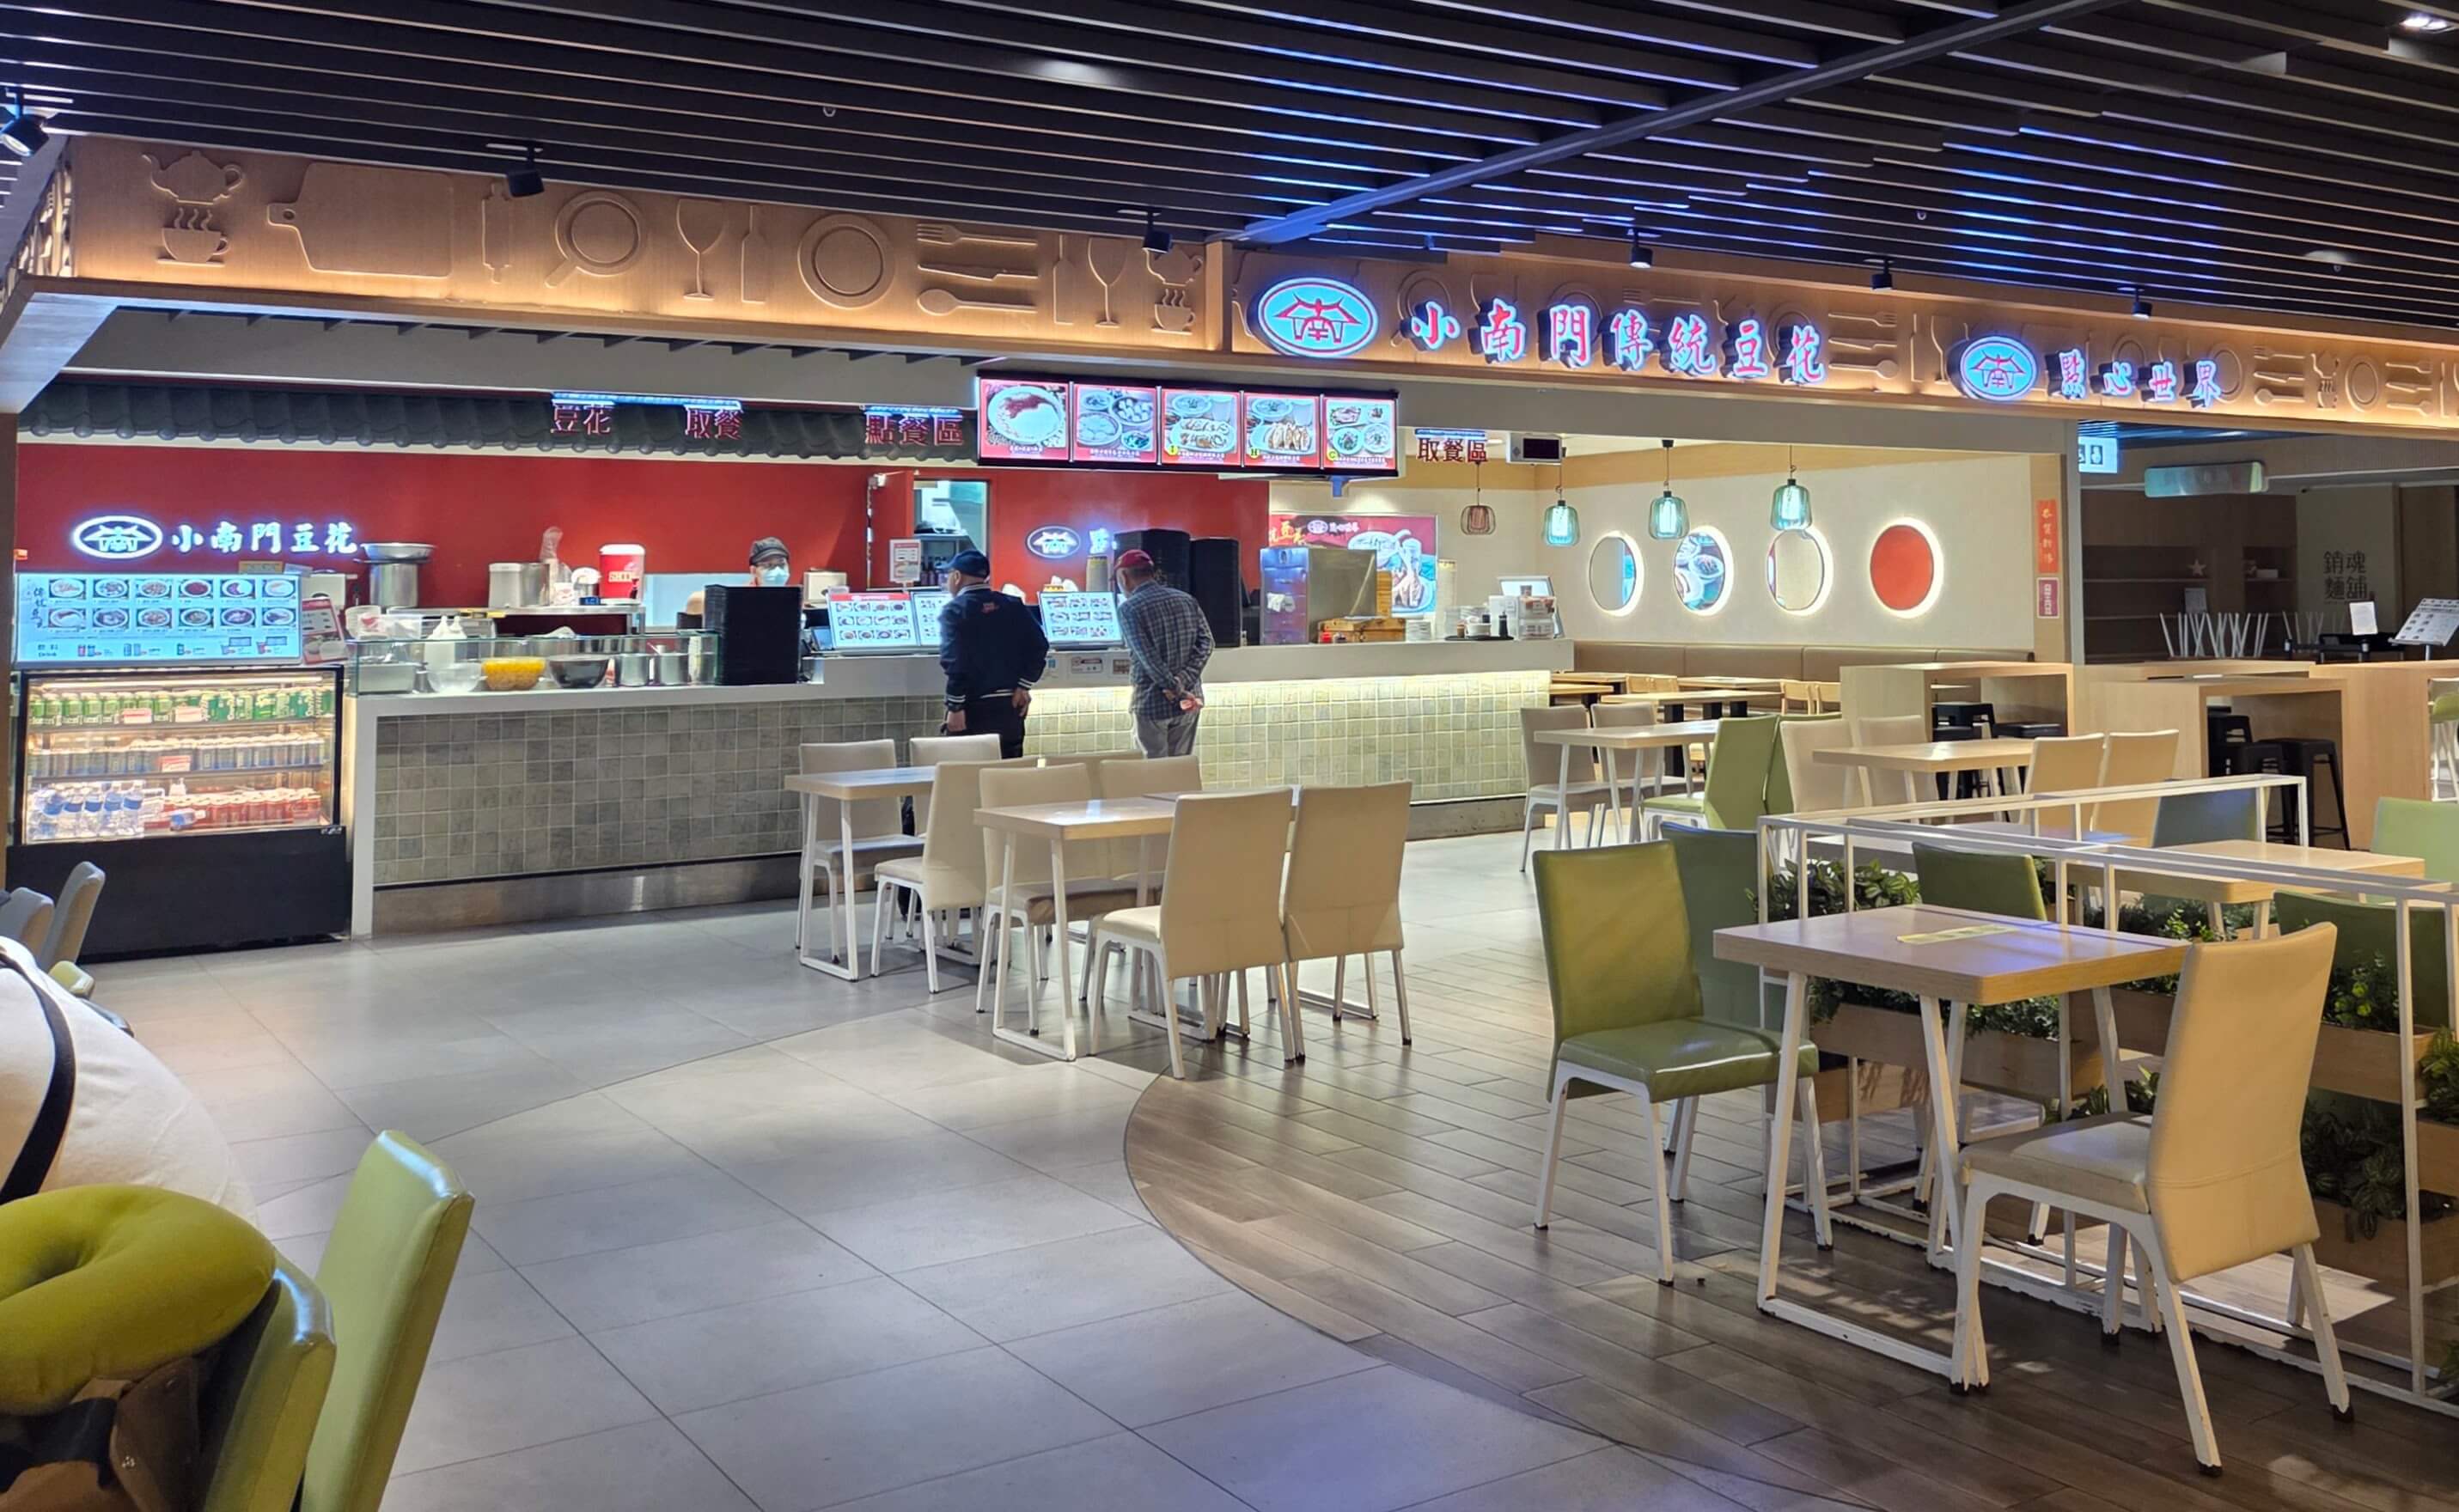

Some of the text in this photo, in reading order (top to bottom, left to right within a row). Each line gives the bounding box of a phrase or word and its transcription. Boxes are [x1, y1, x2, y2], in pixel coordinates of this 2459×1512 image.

[1411, 298, 1825, 383] 小南門傳統豆花
[2059, 348, 2222, 408] 點心世界
[551, 402, 741, 441] 豆花 取餐
[864, 412, 963, 447] 點餐區
[1416, 437, 1488, 463] 取餐區
[172, 521, 357, 554] 小南門豆花
[2322, 550, 2367, 575] 銷魂
